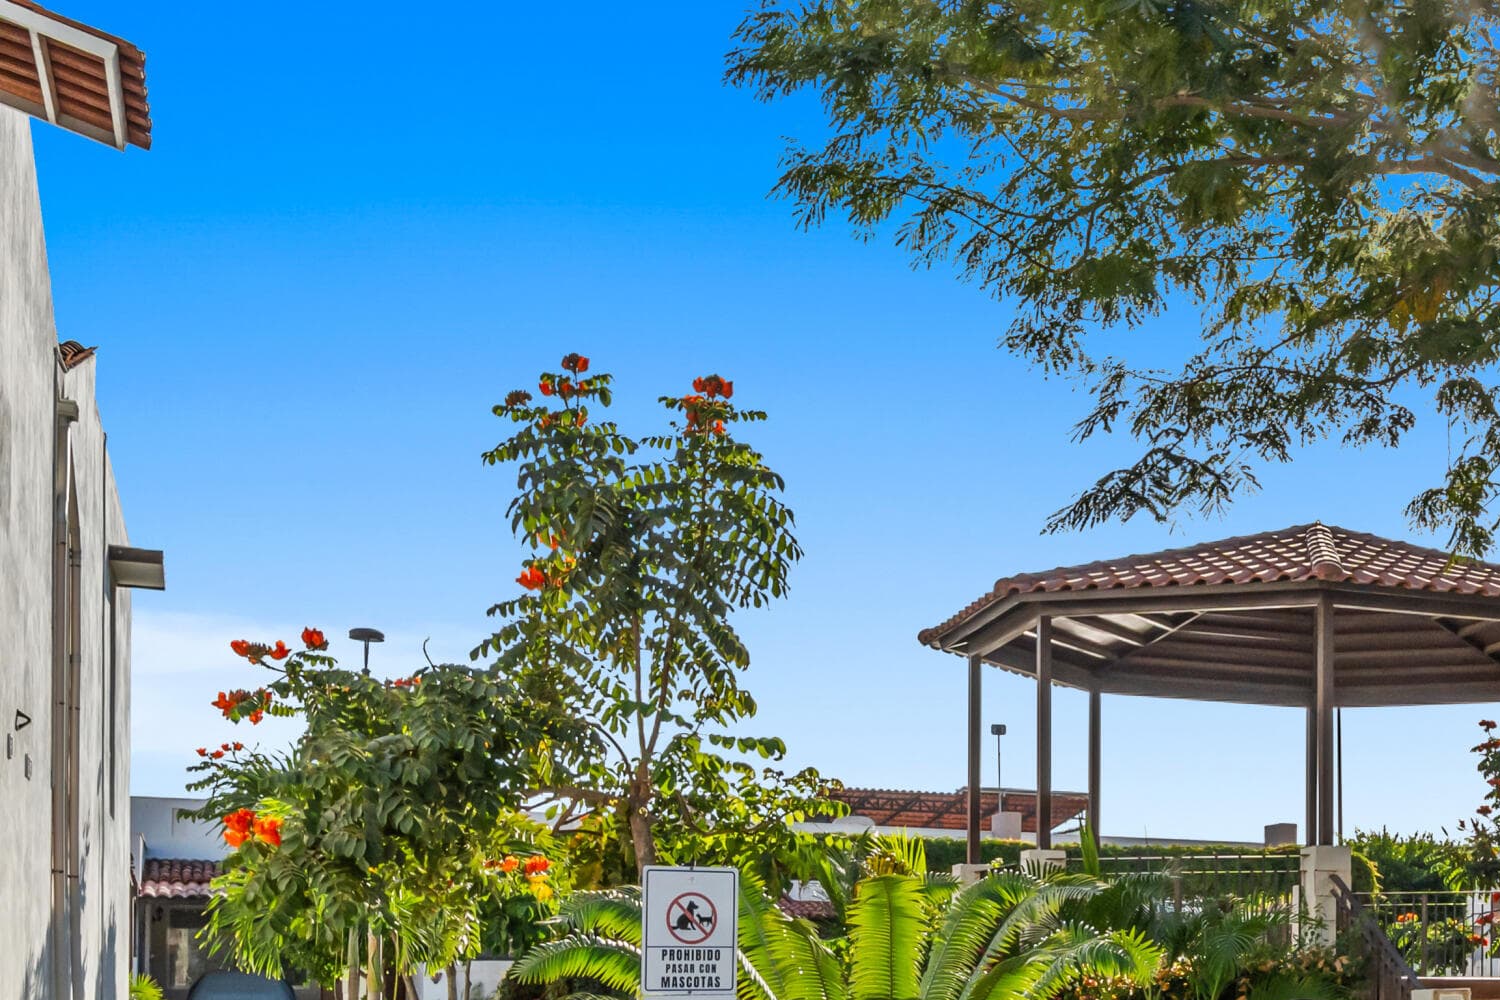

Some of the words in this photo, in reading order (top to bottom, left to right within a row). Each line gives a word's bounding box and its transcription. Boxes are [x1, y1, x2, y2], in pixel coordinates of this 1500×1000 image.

[661, 949, 721, 961] PROHIBIDO
[665, 963, 695, 974] PASAR
[699, 963, 717, 974] CON
[661, 976, 721, 988] MASCOTAS
